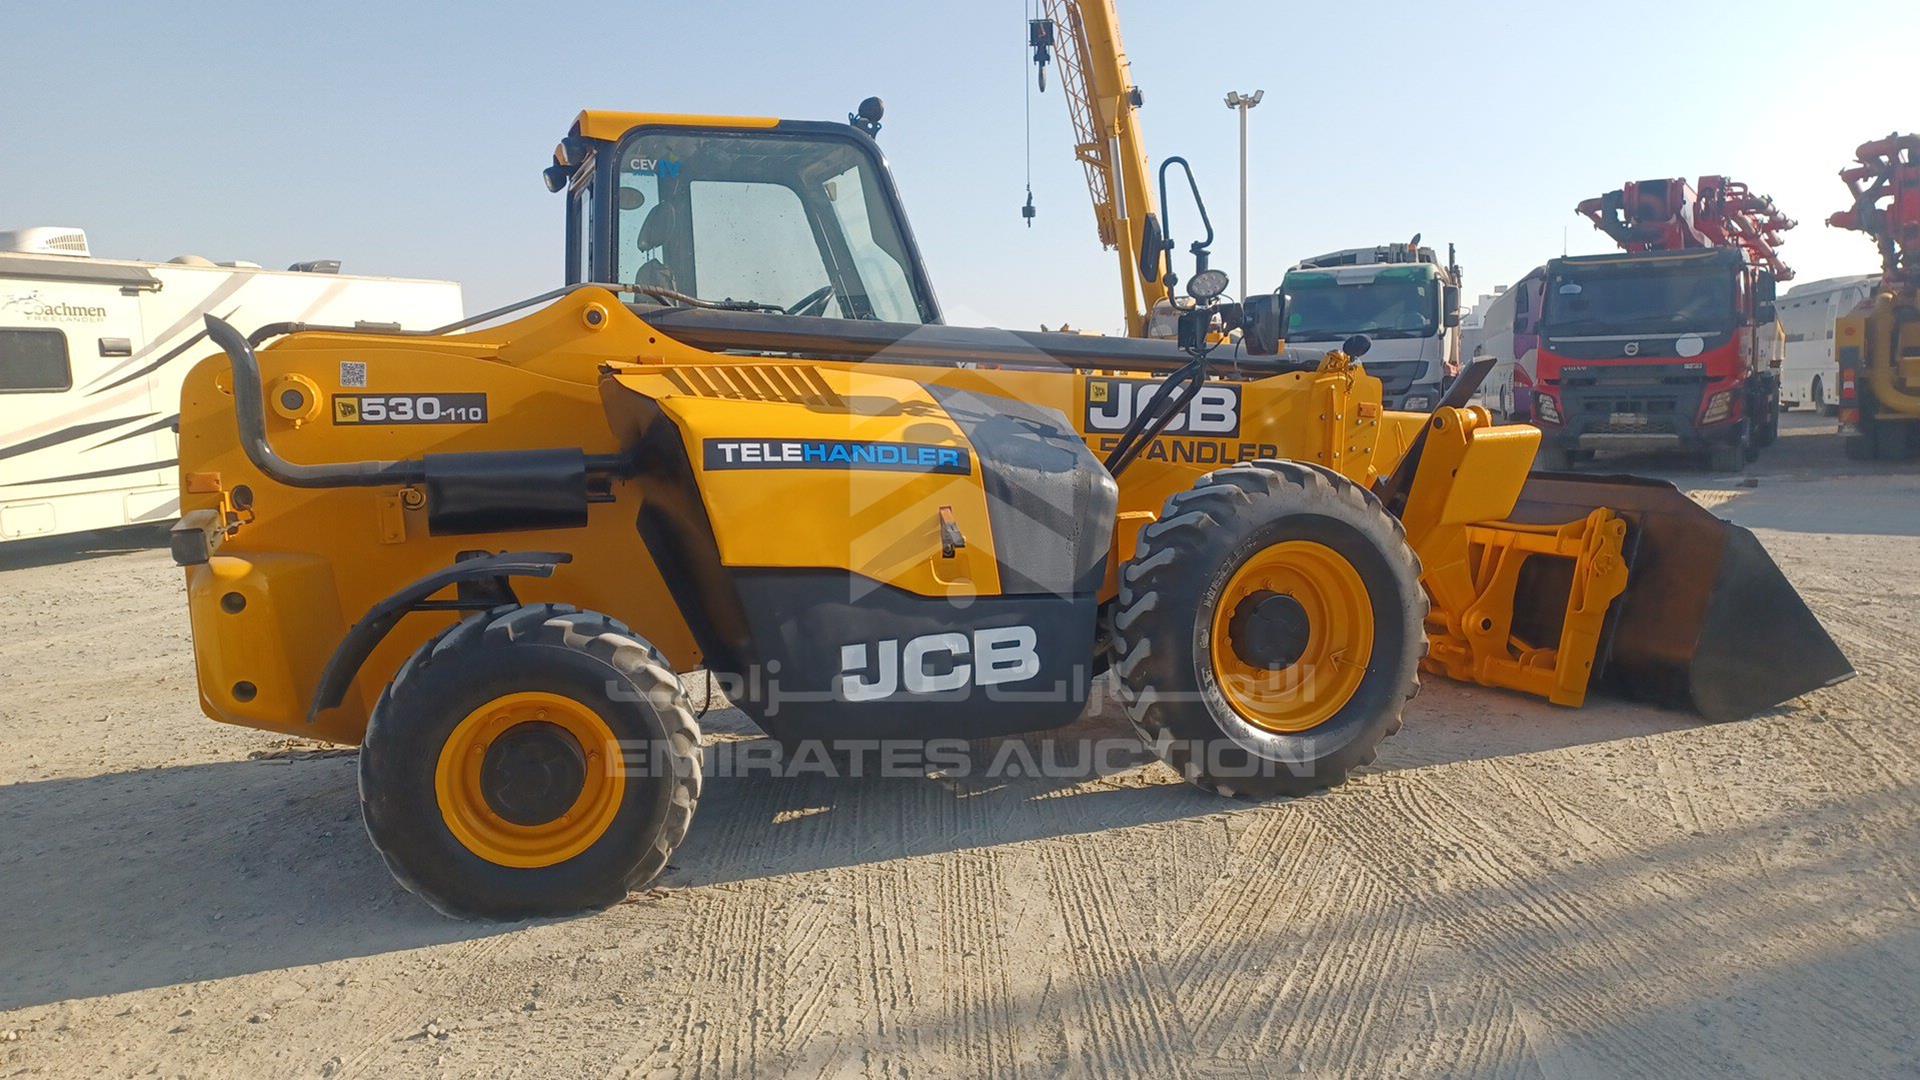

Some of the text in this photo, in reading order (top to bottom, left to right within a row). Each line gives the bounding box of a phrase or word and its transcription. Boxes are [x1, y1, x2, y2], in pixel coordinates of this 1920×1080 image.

[630, 159, 657, 170] CEV
[361, 397, 482, 421] 530-110
[1090, 382, 1238, 433] JCB
[717, 443, 960, 467] TELEHANDLER
[841, 625, 1040, 701] JCB
